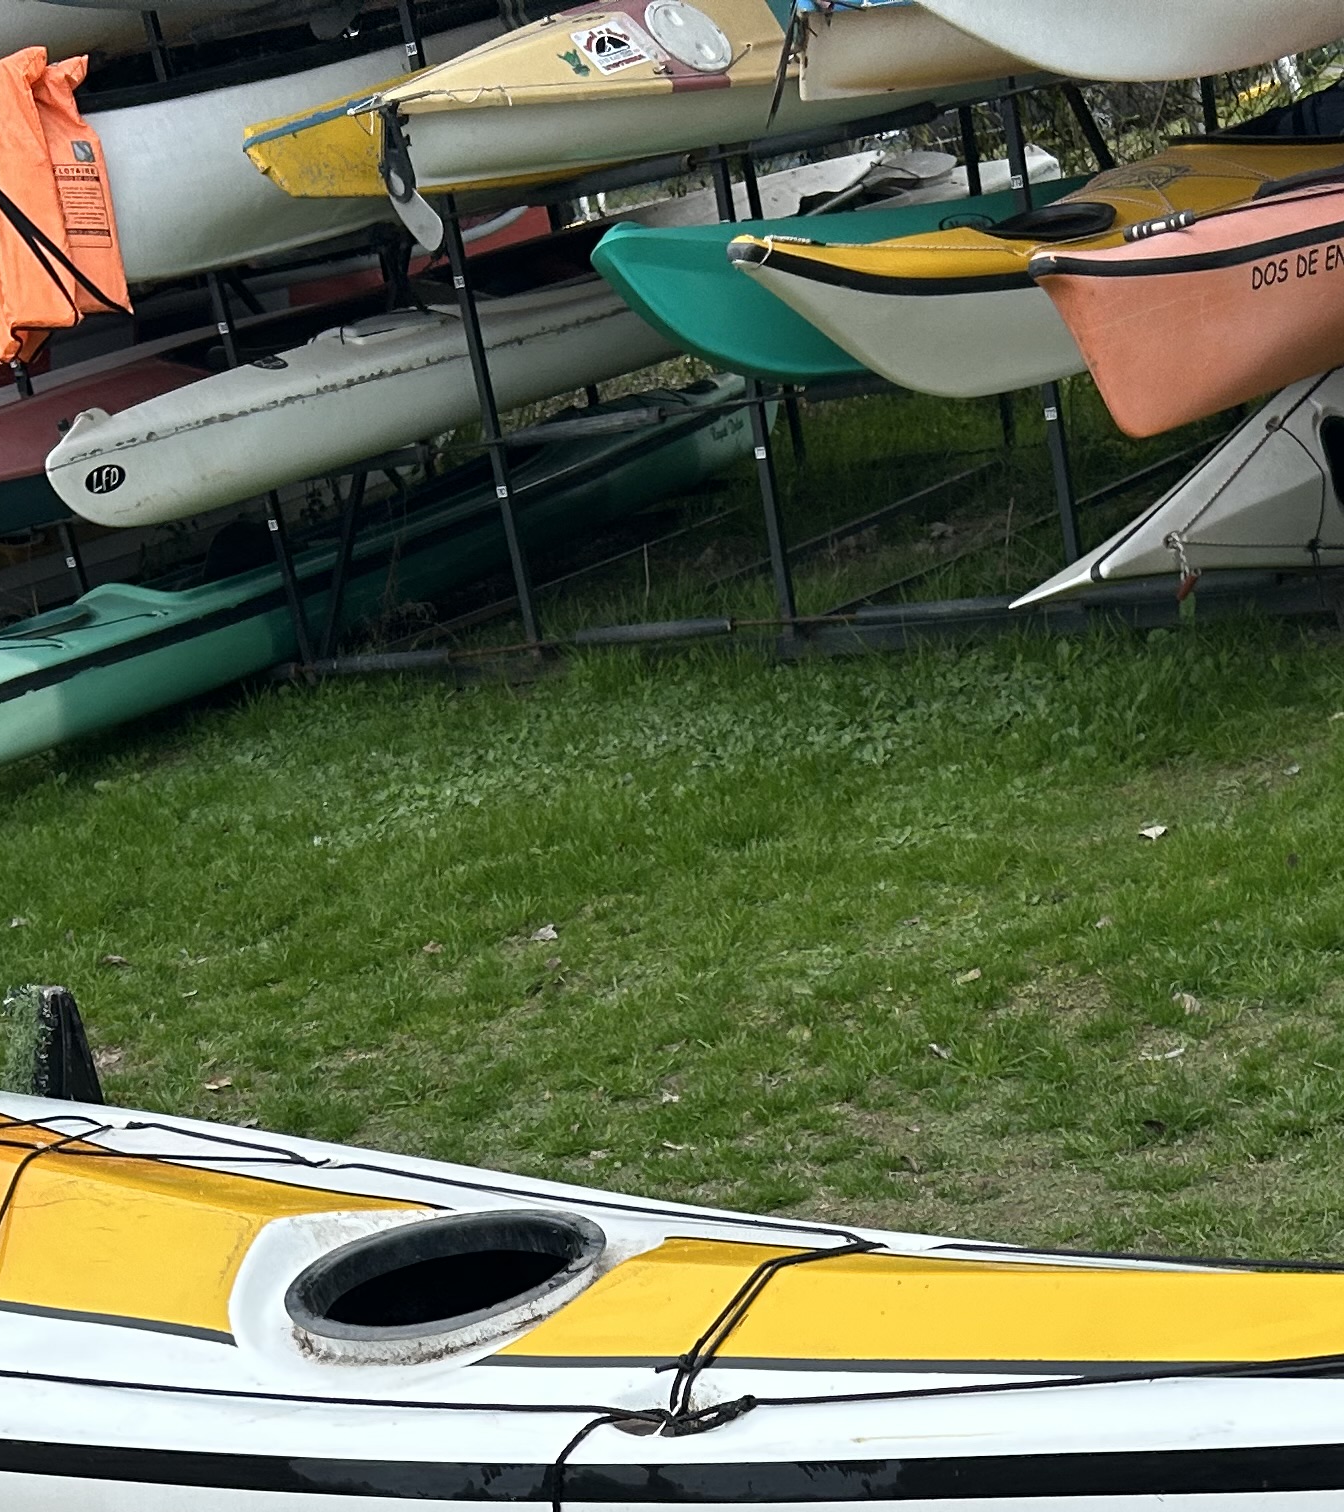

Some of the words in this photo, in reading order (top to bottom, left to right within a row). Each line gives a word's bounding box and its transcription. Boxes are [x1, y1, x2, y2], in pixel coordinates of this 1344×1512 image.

[1252, 258, 1289, 290] DOS
[1296, 249, 1319, 278] DE
[93, 467, 119, 492] LFD
